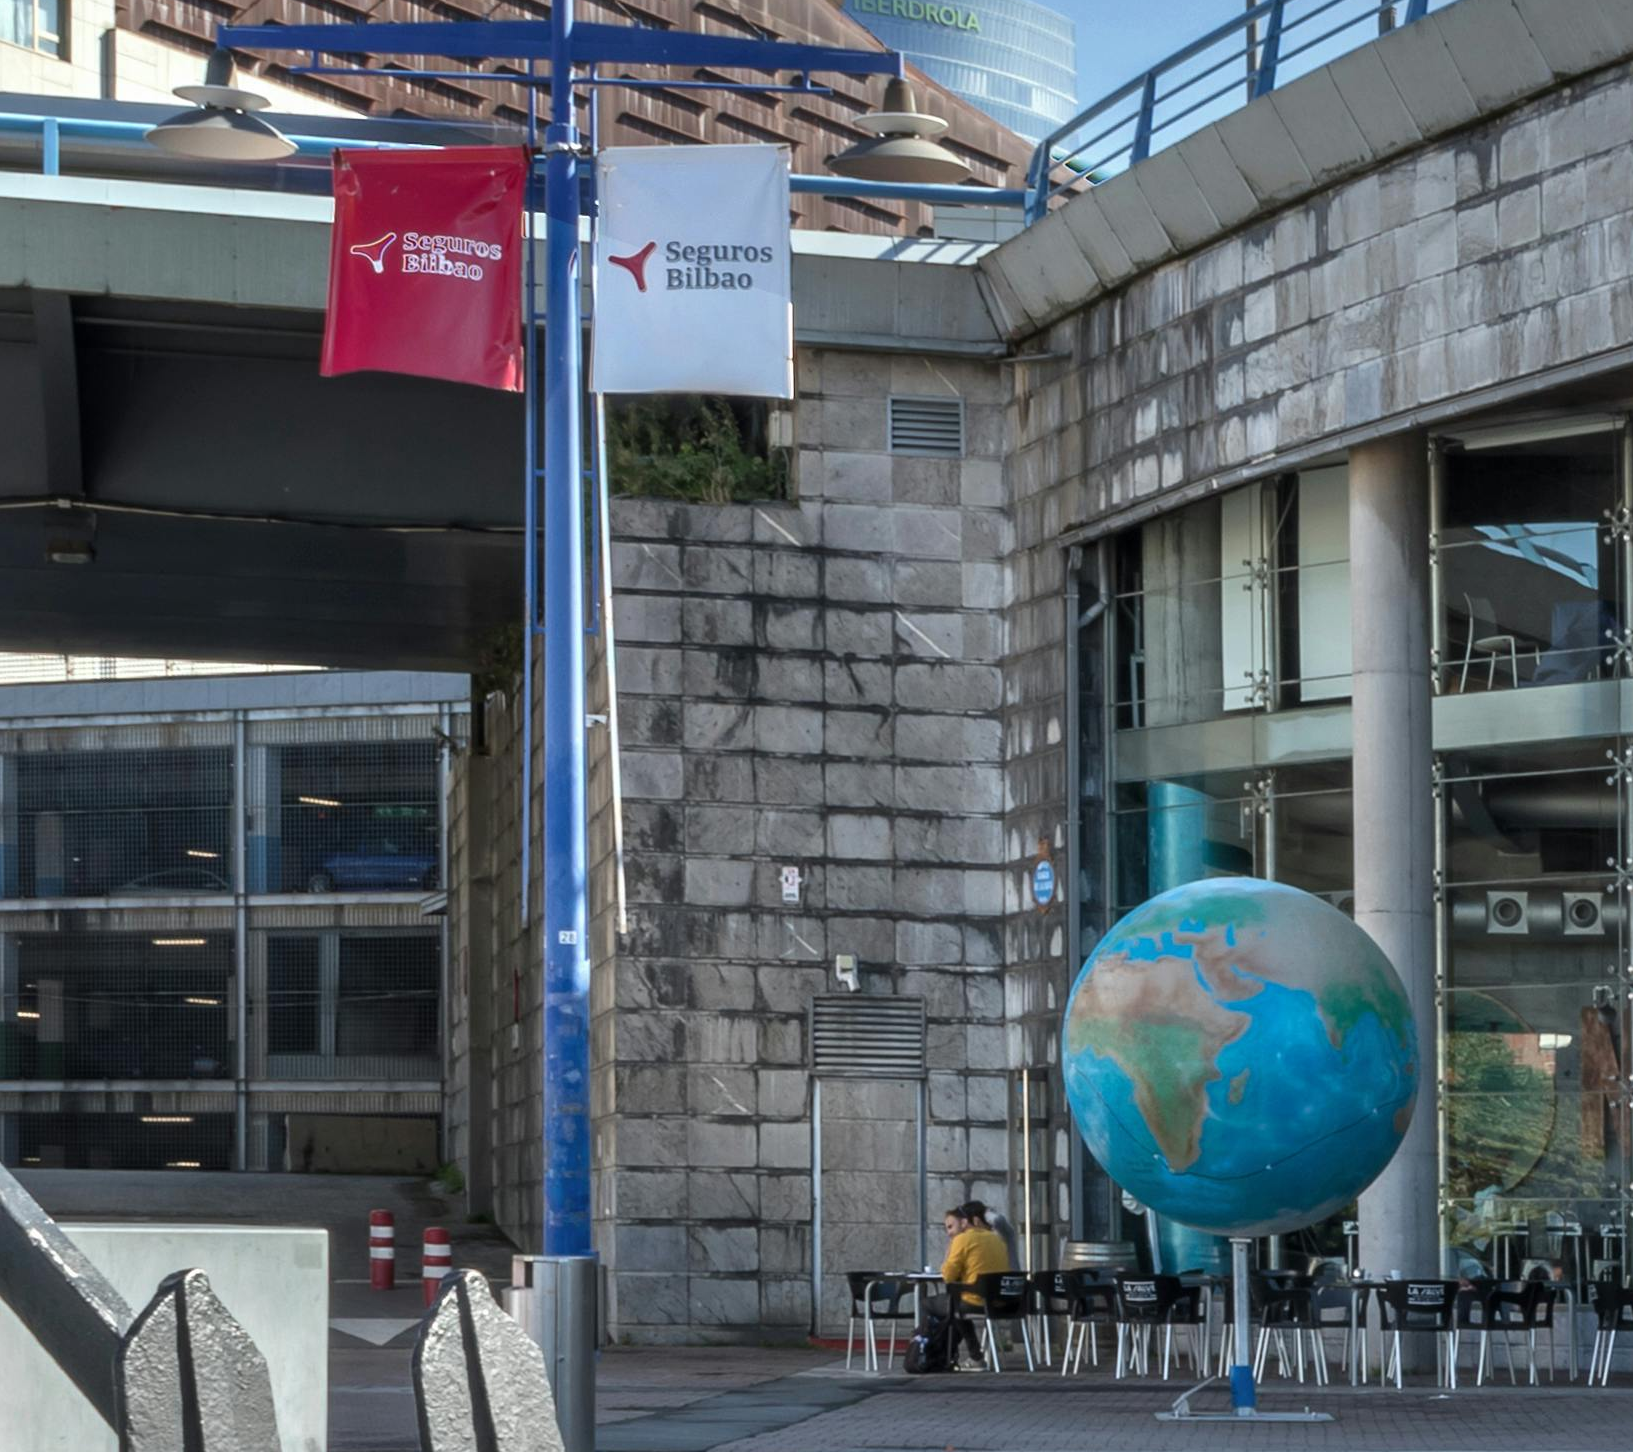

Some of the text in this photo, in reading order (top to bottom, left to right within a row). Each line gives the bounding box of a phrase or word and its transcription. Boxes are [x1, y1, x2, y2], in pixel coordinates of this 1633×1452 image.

[401, 232, 503, 261] Seguros
[665, 241, 774, 267] Seguros
[401, 254, 484, 281] Bilbao
[666, 267, 754, 291] Bilbao
